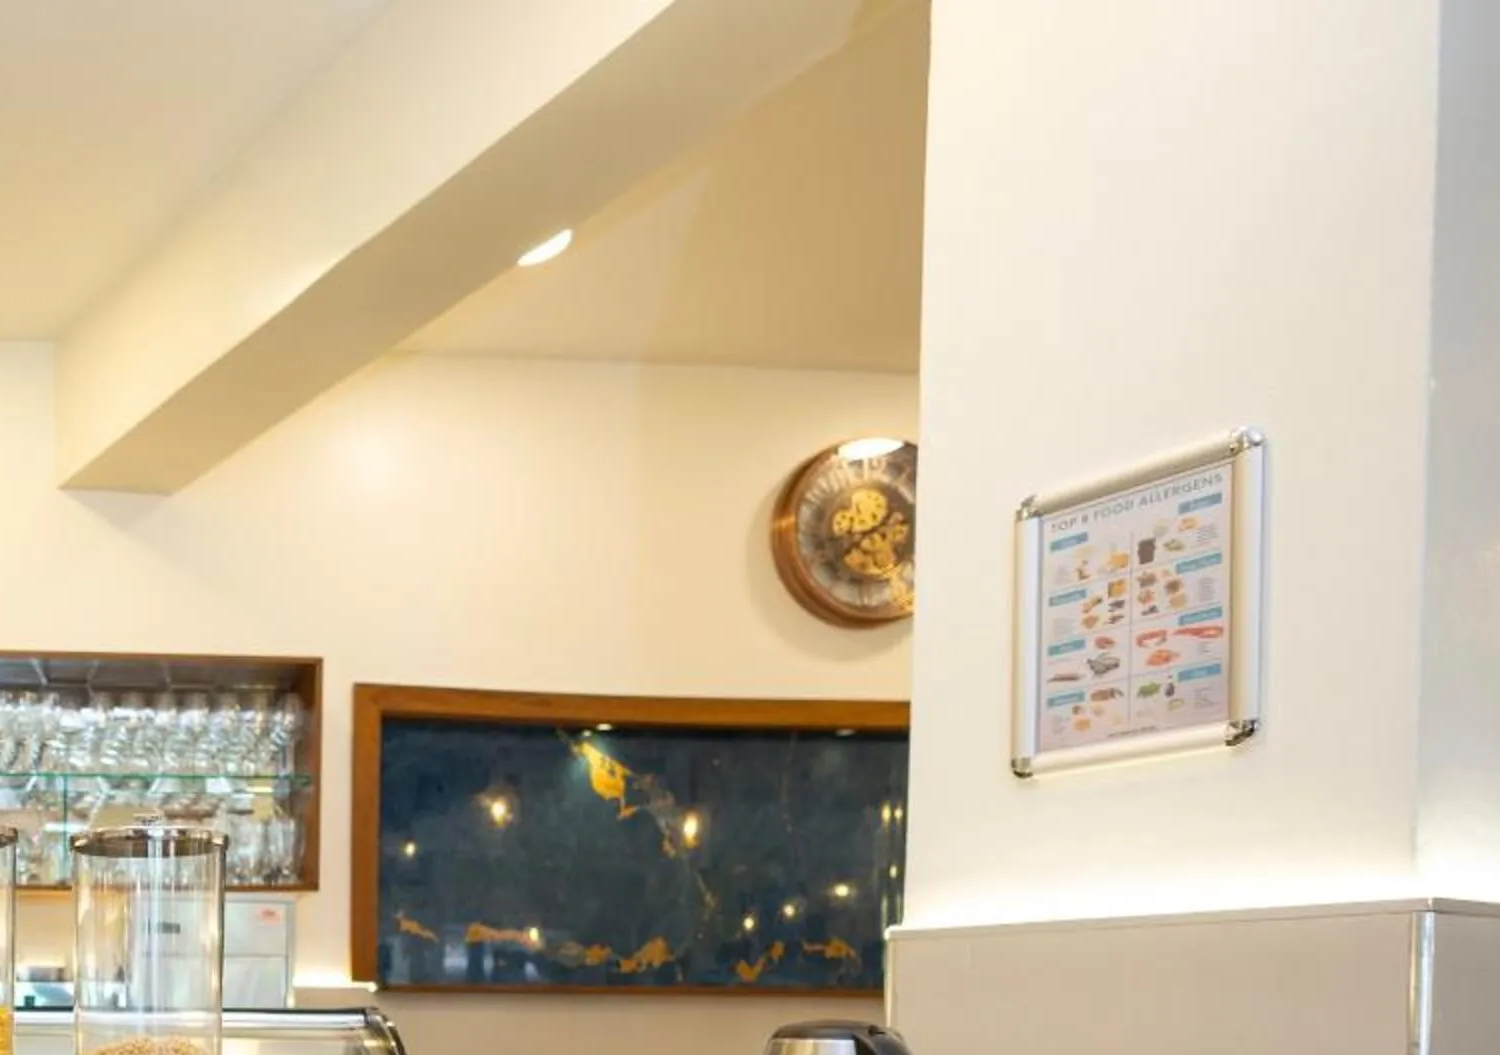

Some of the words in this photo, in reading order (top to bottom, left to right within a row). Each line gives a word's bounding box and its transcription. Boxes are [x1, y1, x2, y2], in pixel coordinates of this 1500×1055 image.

[1051, 517, 1077, 532] TOP
[1094, 501, 1135, 522] FOOD
[1138, 473, 1224, 507] ALLERGENS
